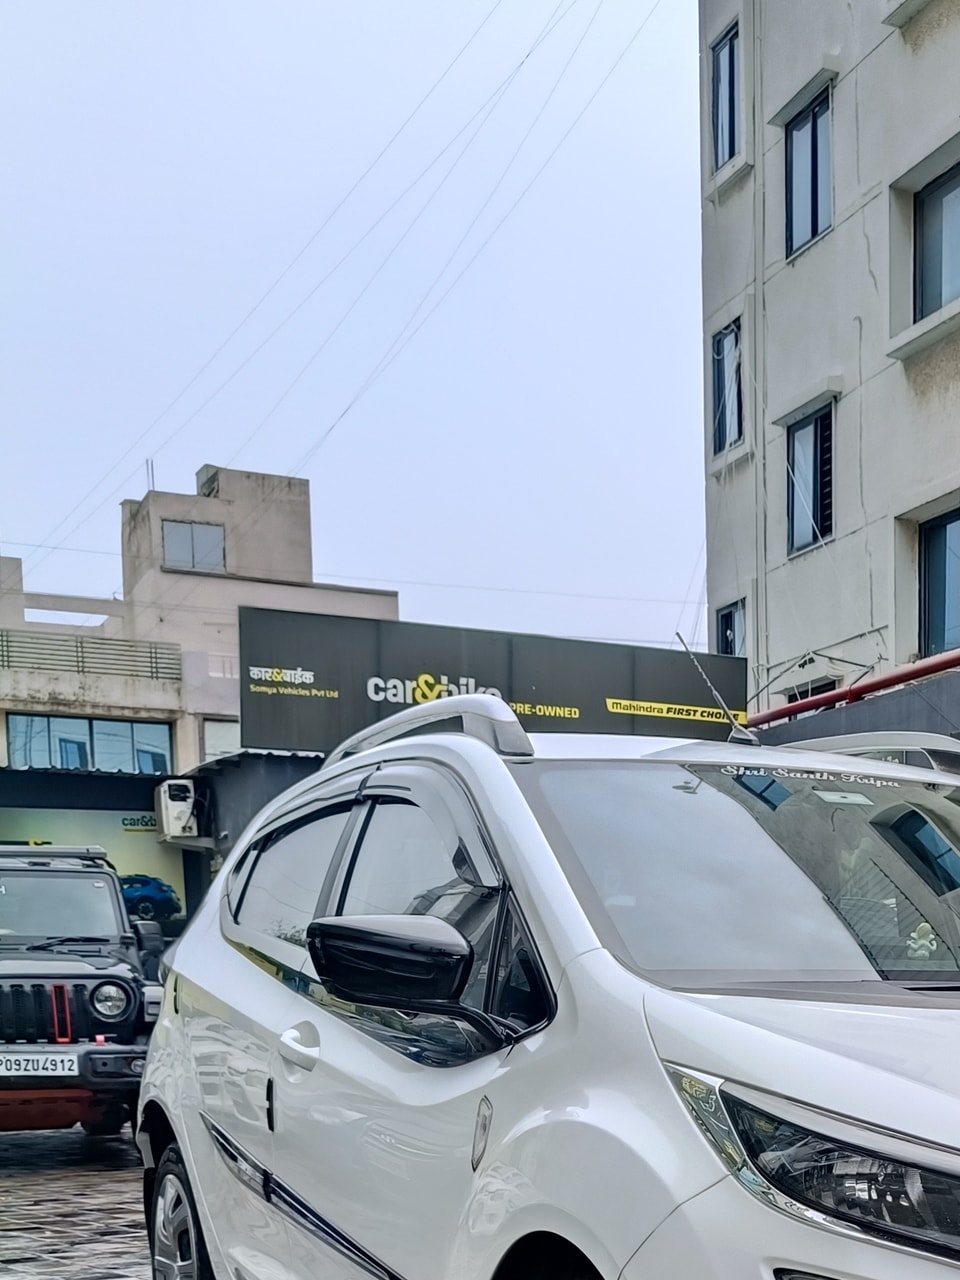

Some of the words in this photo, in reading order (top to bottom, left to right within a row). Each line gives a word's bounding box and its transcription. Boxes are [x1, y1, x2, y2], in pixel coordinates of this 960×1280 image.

[250, 684, 277, 695] Somya
[278, 687, 310, 697] Vehicles
[311, 689, 324, 698] Pvt
[510, 702, 580, 719] PRE-OWNED
[611, 701, 664, 714] Mahindra
[666, 706, 699, 717] FIRST
[700, 710, 740, 721] CHOIE
[720, 765, 768, 777] Shri
